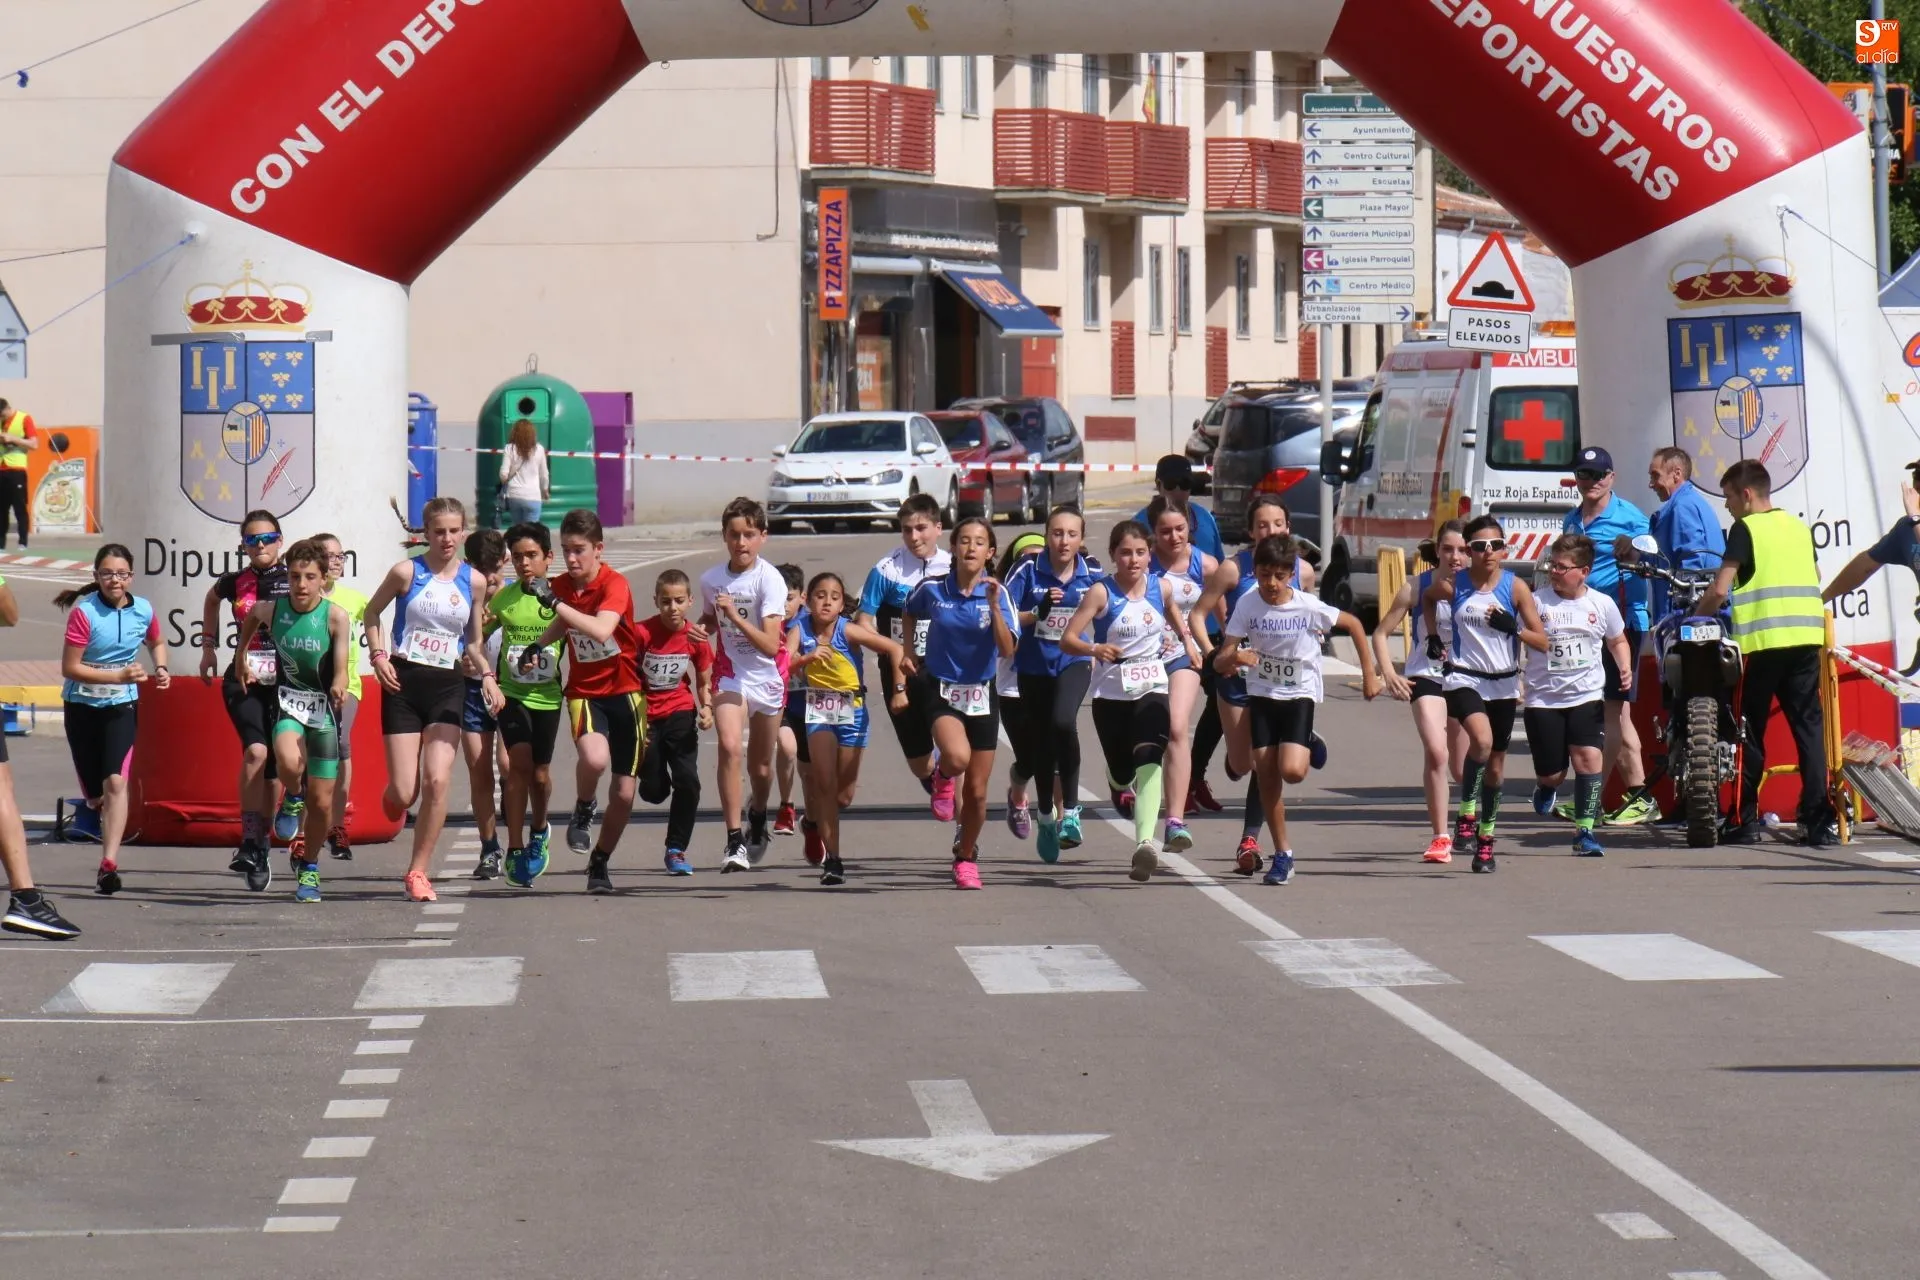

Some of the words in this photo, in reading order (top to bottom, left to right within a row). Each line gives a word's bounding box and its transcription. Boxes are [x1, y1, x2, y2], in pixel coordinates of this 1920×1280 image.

[231, 123, 325, 213] CON
[318, 79, 384, 132] EL
[376, 0, 486, 78] DEP
[1353, 126, 1411, 135] Ayuntamiento
[1375, 151, 1410, 160] Cultural
[1385, 204, 1409, 212] Mayor
[1371, 229, 1411, 238] Municipal
[1342, 255, 1368, 264] Iglesia
[1370, 255, 1411, 264] Parroquial
[1349, 281, 1378, 289] Centro
[1468, 317, 1511, 329] PASOS
[1455, 331, 1521, 344] ELEVADOS
[1482, 488, 1501, 498] ruz
[1504, 486, 1529, 501] Roja
[1532, 485, 1580, 502] Española
[1507, 518, 1538, 529] 0130
[1047, 616, 1069, 629] 50
[1261, 615, 1308, 631] ARMUÑA
[419, 637, 450, 654] 401
[579, 639, 605, 650] 41
[1554, 642, 1583, 658] 511
[649, 662, 679, 674] 412
[1130, 665, 1159, 681] 503
[1263, 661, 1294, 677] 810
[950, 688, 982, 703] 510
[287, 698, 317, 714] 404
[815, 697, 844, 711] 501
